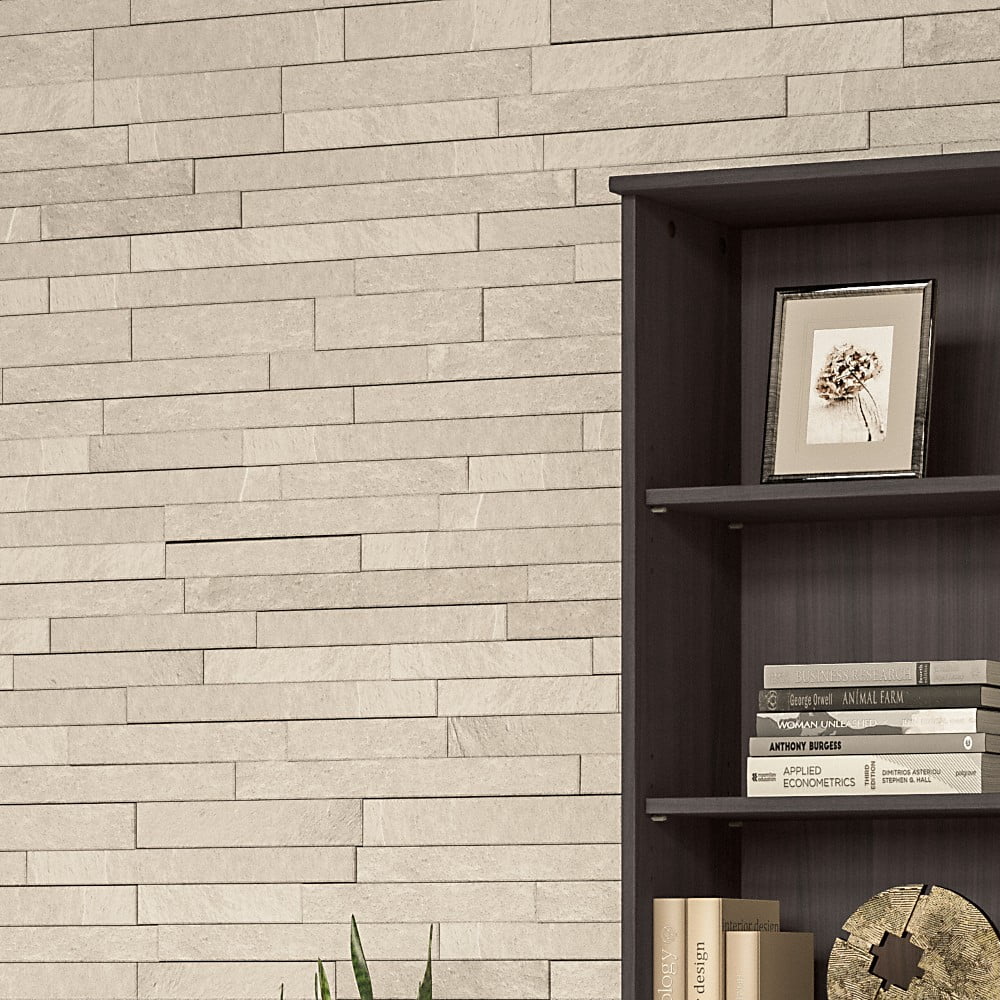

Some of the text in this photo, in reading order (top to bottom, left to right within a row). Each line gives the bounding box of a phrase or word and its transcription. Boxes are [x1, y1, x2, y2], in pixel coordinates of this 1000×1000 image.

[794, 669, 848, 684] BUSINESS
[789, 692, 812, 708] George
[812, 692, 833, 706] Orwell
[880, 689, 905, 704] FARM
[777, 718, 877, 730] WOMAN UNLEASHED
[769, 740, 842, 752] ANTHONY BURGESS
[782, 765, 822, 777] APPLIED
[912, 768, 942, 776] ASTERIOU
[783, 777, 856, 789] ECONOMETRICS
[693, 941, 708, 994] design
